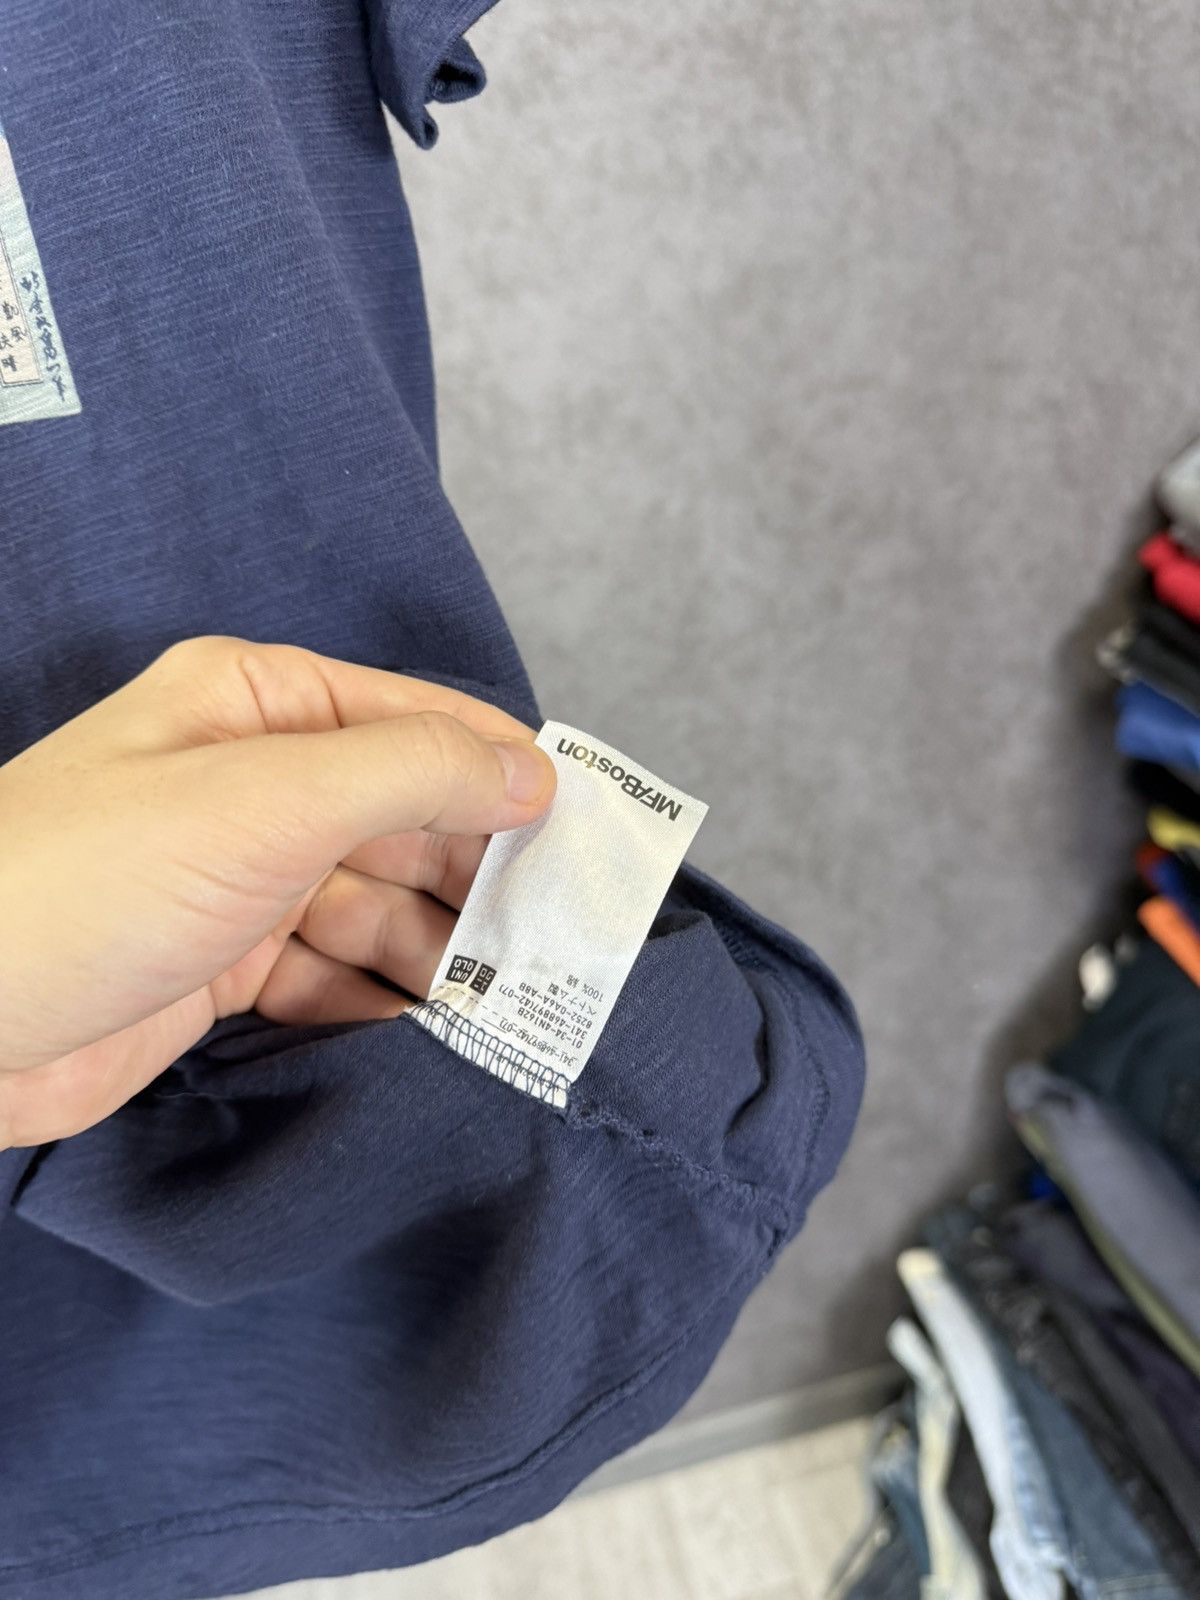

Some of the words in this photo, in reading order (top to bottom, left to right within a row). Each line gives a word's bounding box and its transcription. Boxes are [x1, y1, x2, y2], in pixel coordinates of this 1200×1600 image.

[499, 984, 588, 1040] 341-468897(42-07)
[547, 982, 597, 1015] ベトナム製
